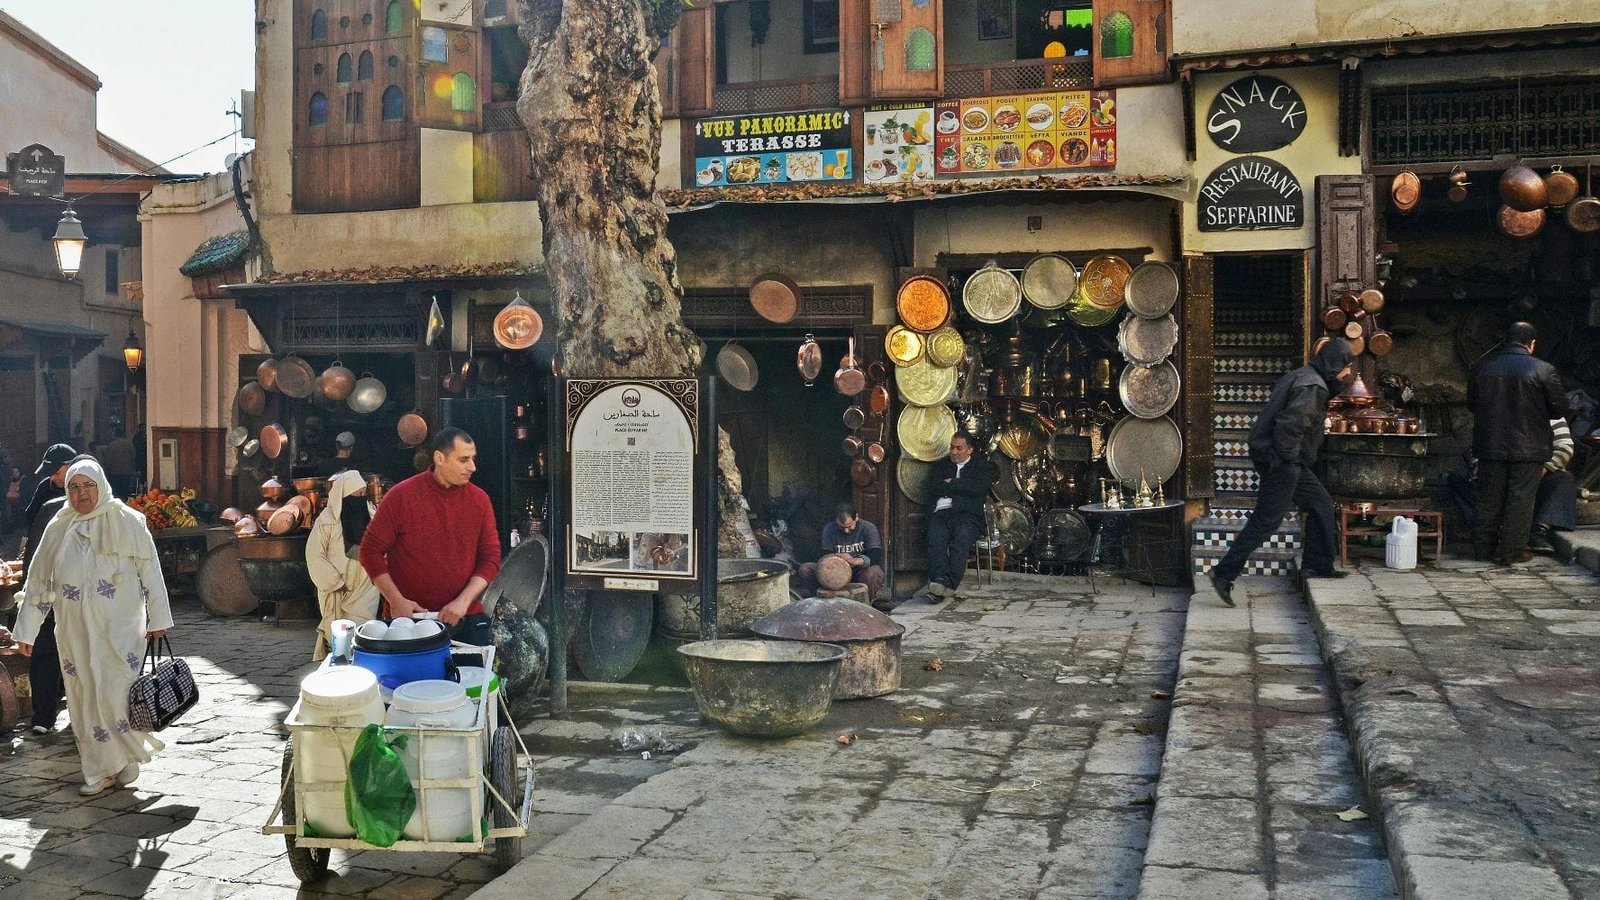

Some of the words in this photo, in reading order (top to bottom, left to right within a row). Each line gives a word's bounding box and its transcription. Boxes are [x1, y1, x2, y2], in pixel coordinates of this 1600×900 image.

[1208, 79, 1305, 145] SNACK
[702, 120, 735, 138] VUE
[740, 112, 843, 136] PANORAMIC
[722, 134, 822, 153] TERASSE
[1201, 161, 1300, 203] RESTAURANT
[1206, 204, 1296, 225] SEFFARINE
[603, 409, 639, 421] الصفارين
[641, 409, 660, 418] ساحة
